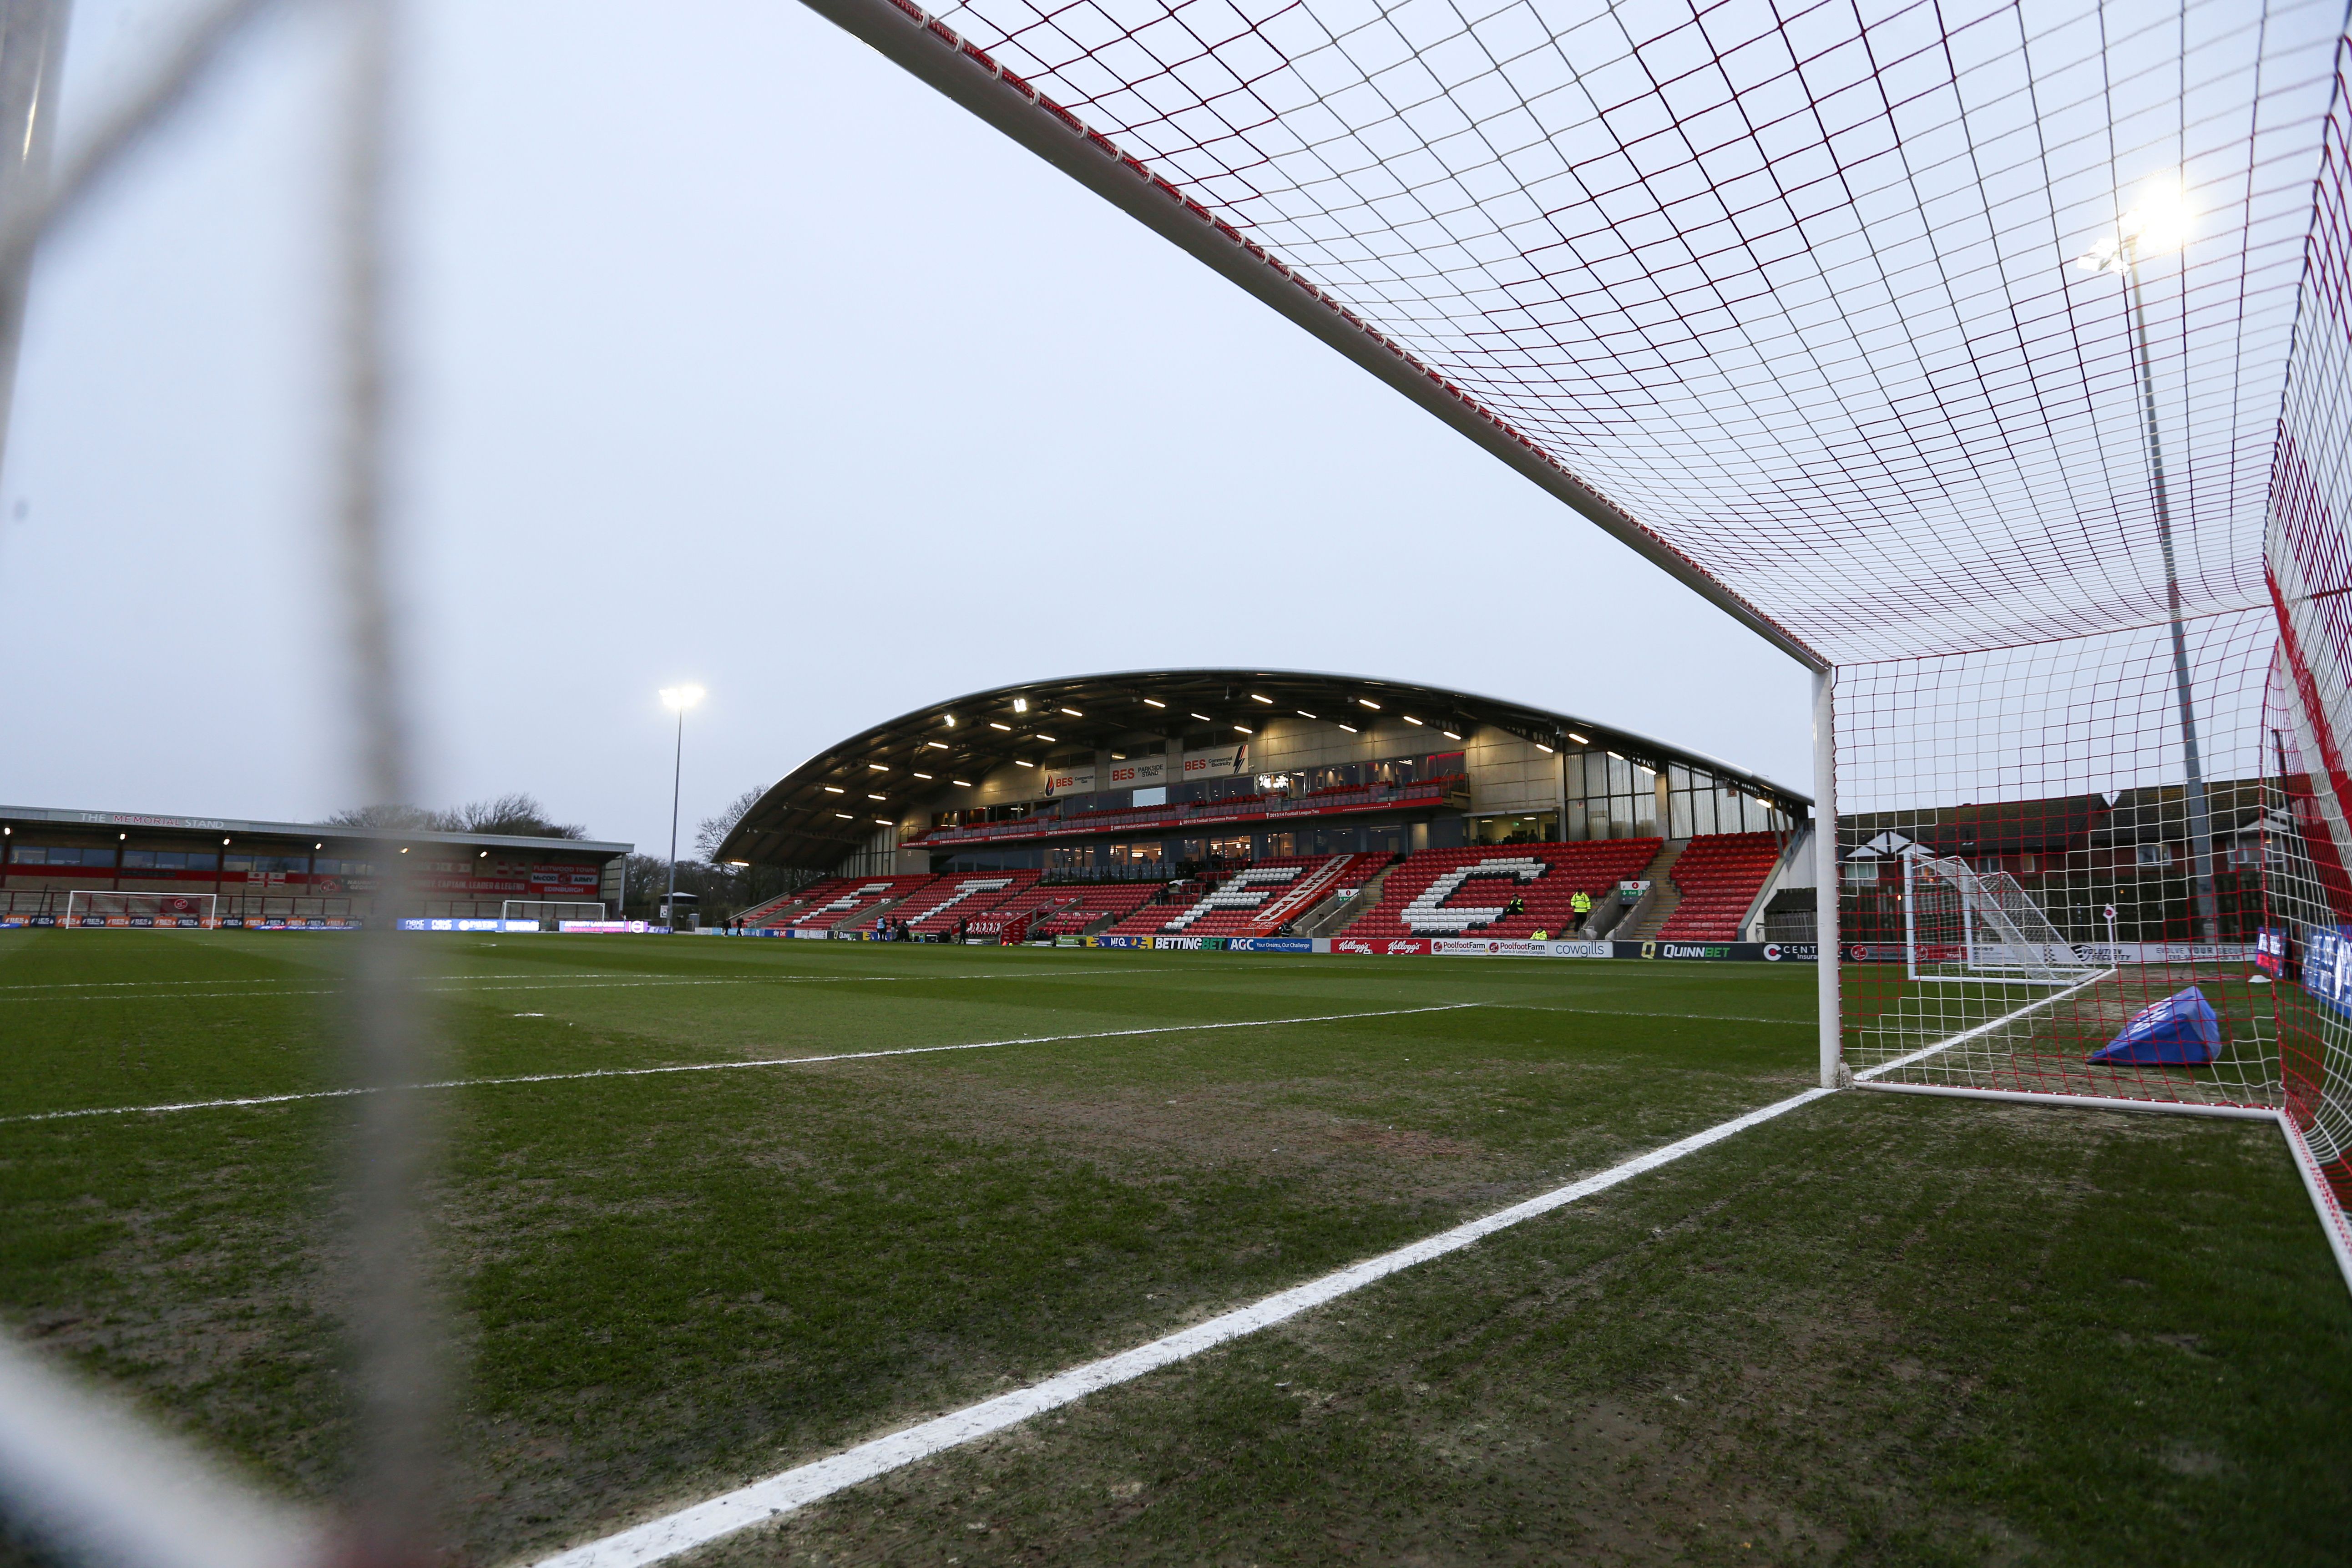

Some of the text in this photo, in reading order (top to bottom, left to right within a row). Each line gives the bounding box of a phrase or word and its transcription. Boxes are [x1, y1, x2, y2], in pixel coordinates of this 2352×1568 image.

[1185, 759, 1206, 771] BES
[1113, 768, 1134, 781] BES
[1056, 777, 1072, 787] BES
[81, 813, 223, 829] THE MEMORIAL STAND
[1111, 937, 1127, 946] MrQ
[1230, 939, 1254, 951] AGC
[1339, 940, 1370, 953] Kellogg's
[1388, 940, 1420, 953] Kellogg's
[1500, 942, 1545, 950] PoolfootFarm
[1556, 941, 1604, 957] cowgills
[1663, 944, 1730, 958] QUINNBET
